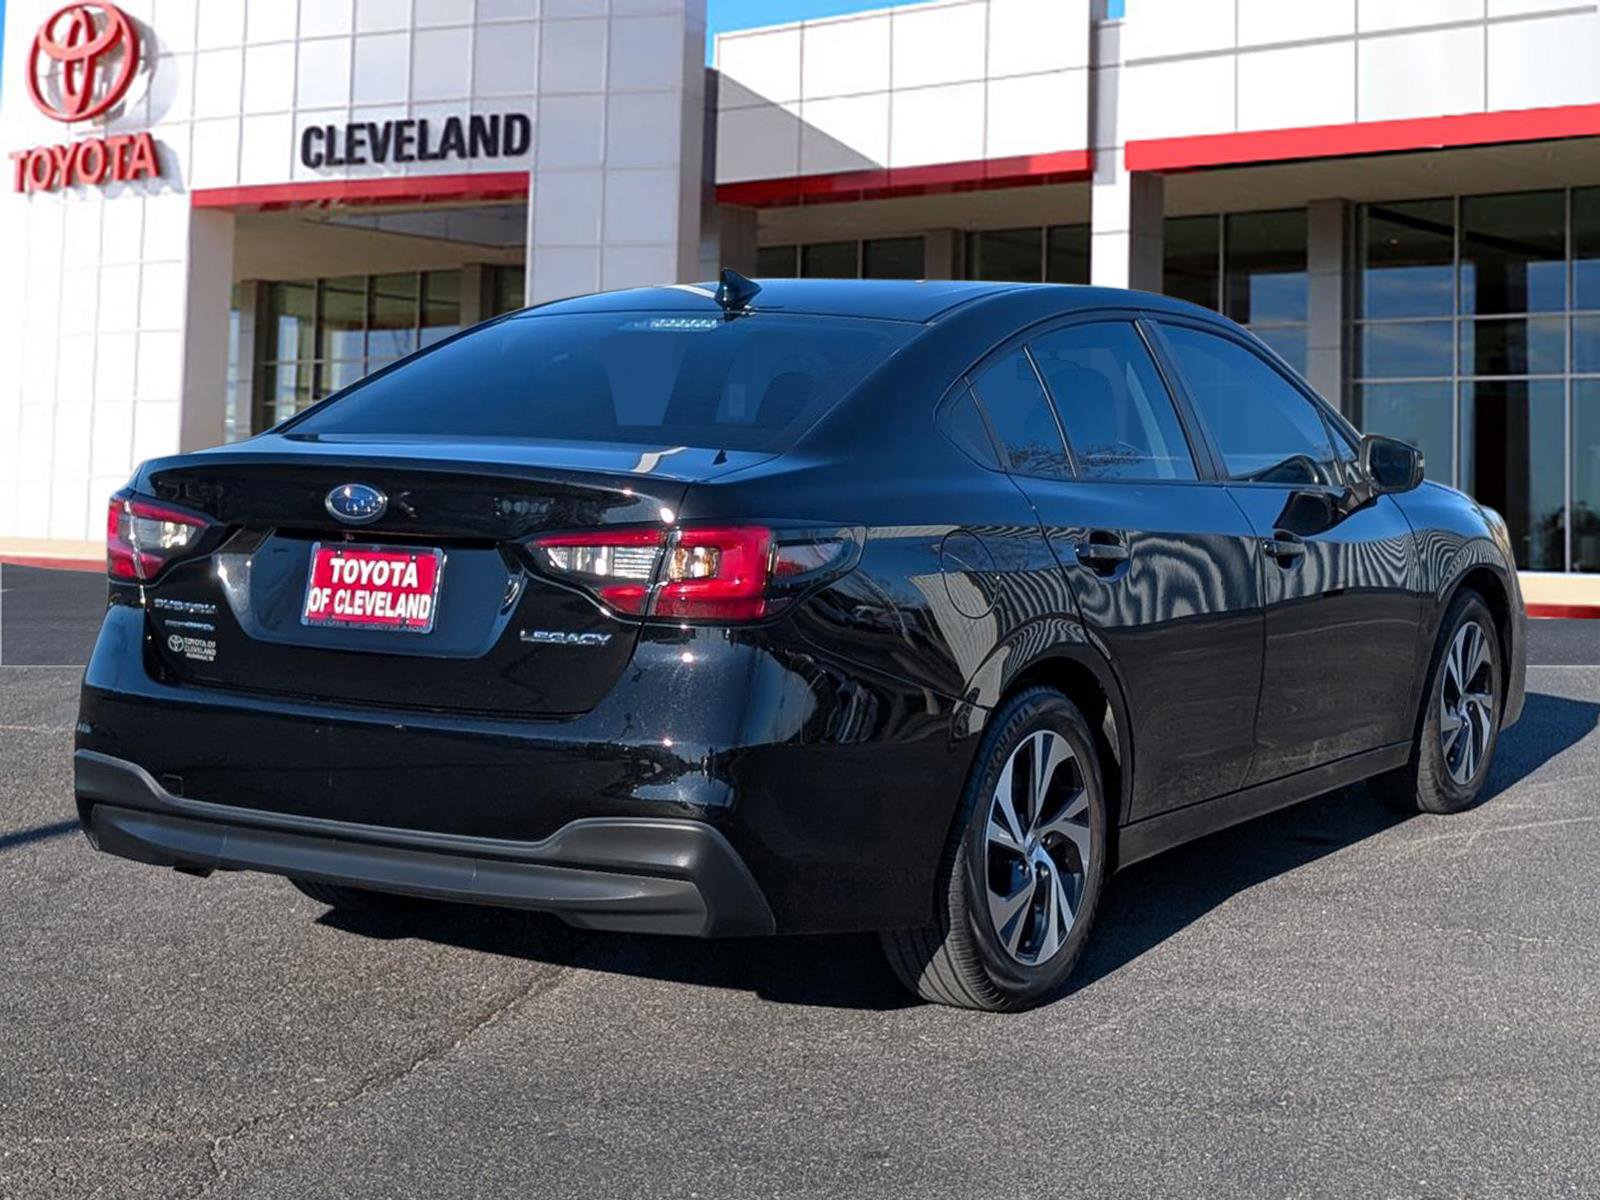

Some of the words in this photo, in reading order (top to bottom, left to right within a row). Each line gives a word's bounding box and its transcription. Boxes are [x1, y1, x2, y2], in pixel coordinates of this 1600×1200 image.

[301, 113, 531, 169] CLEVELAND
[9, 133, 160, 192] TOYOTA
[330, 557, 418, 588] TOYOTA
[308, 587, 331, 612] OF
[334, 589, 432, 620] CLEVELAND
[520, 630, 612, 645] LEGACY
